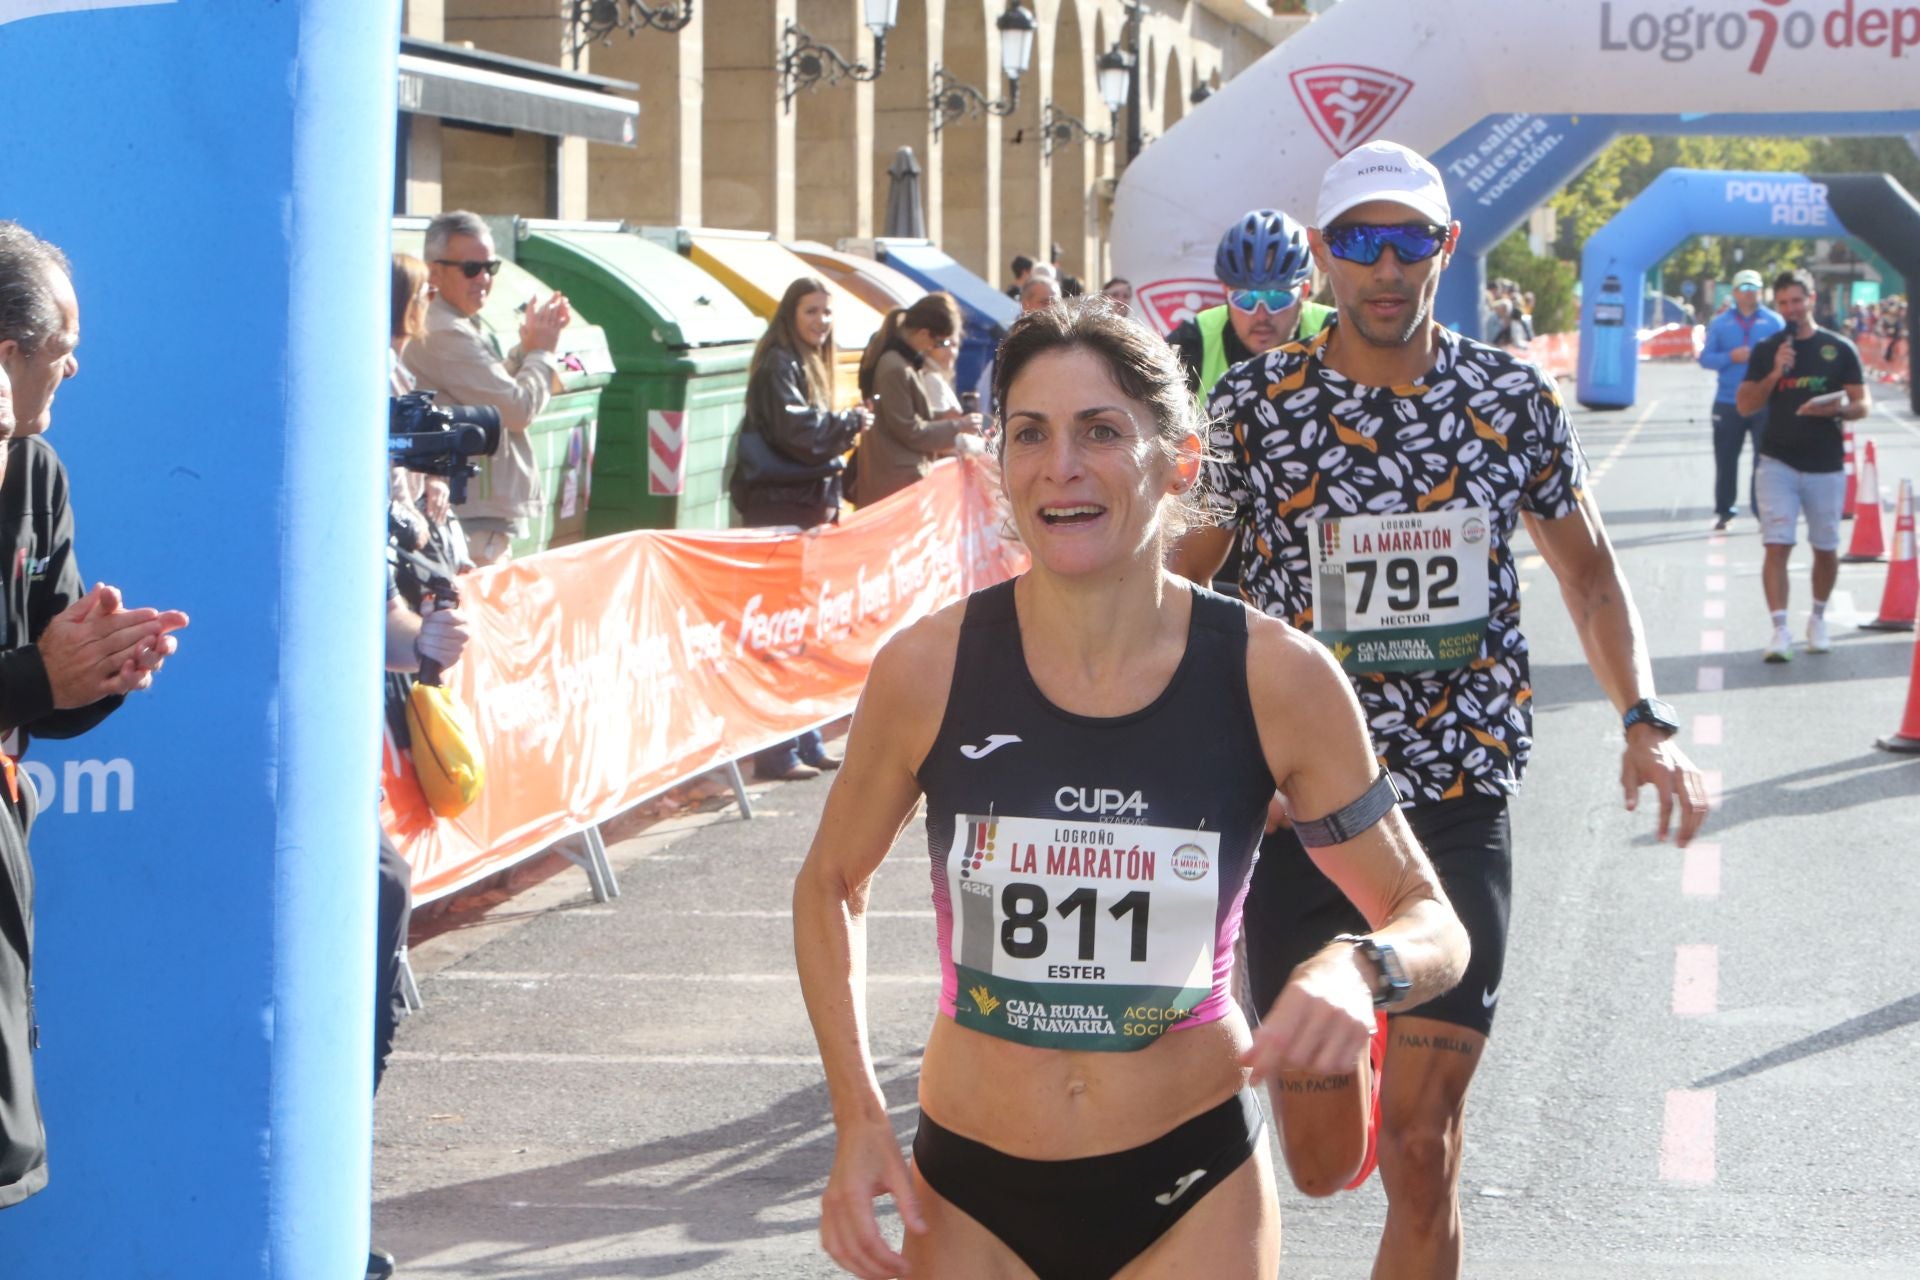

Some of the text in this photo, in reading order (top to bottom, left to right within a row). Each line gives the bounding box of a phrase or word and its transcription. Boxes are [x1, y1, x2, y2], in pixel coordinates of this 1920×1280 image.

[1467, 118, 1548, 192] nuestra
[1358, 165, 1402, 176] KIPRUN
[1447, 154, 1480, 178] Tu
[1725, 180, 1828, 204] POWER
[1771, 203, 1828, 226] ADE
[1381, 519, 1422, 530] LOGROÑO
[1353, 526, 1452, 554] LA MARATÓN
[1346, 556, 1459, 614] 792
[1380, 614, 1431, 626] HECTOR
[1357, 638, 1429, 652] CAJA RURAL
[1358, 649, 1435, 663] DE NAVARRA
[1055, 786, 1149, 817] CUPA
[1054, 828, 1115, 846] LOGROÑO
[1010, 843, 1155, 881] LA MARATÓN
[961, 881, 992, 898] 42K
[1001, 882, 1150, 962] 811
[1047, 965, 1106, 980] ESTER
[1006, 1000, 1109, 1019] CAJA RURAL
[1007, 1013, 1116, 1034] DE NAVARRA
